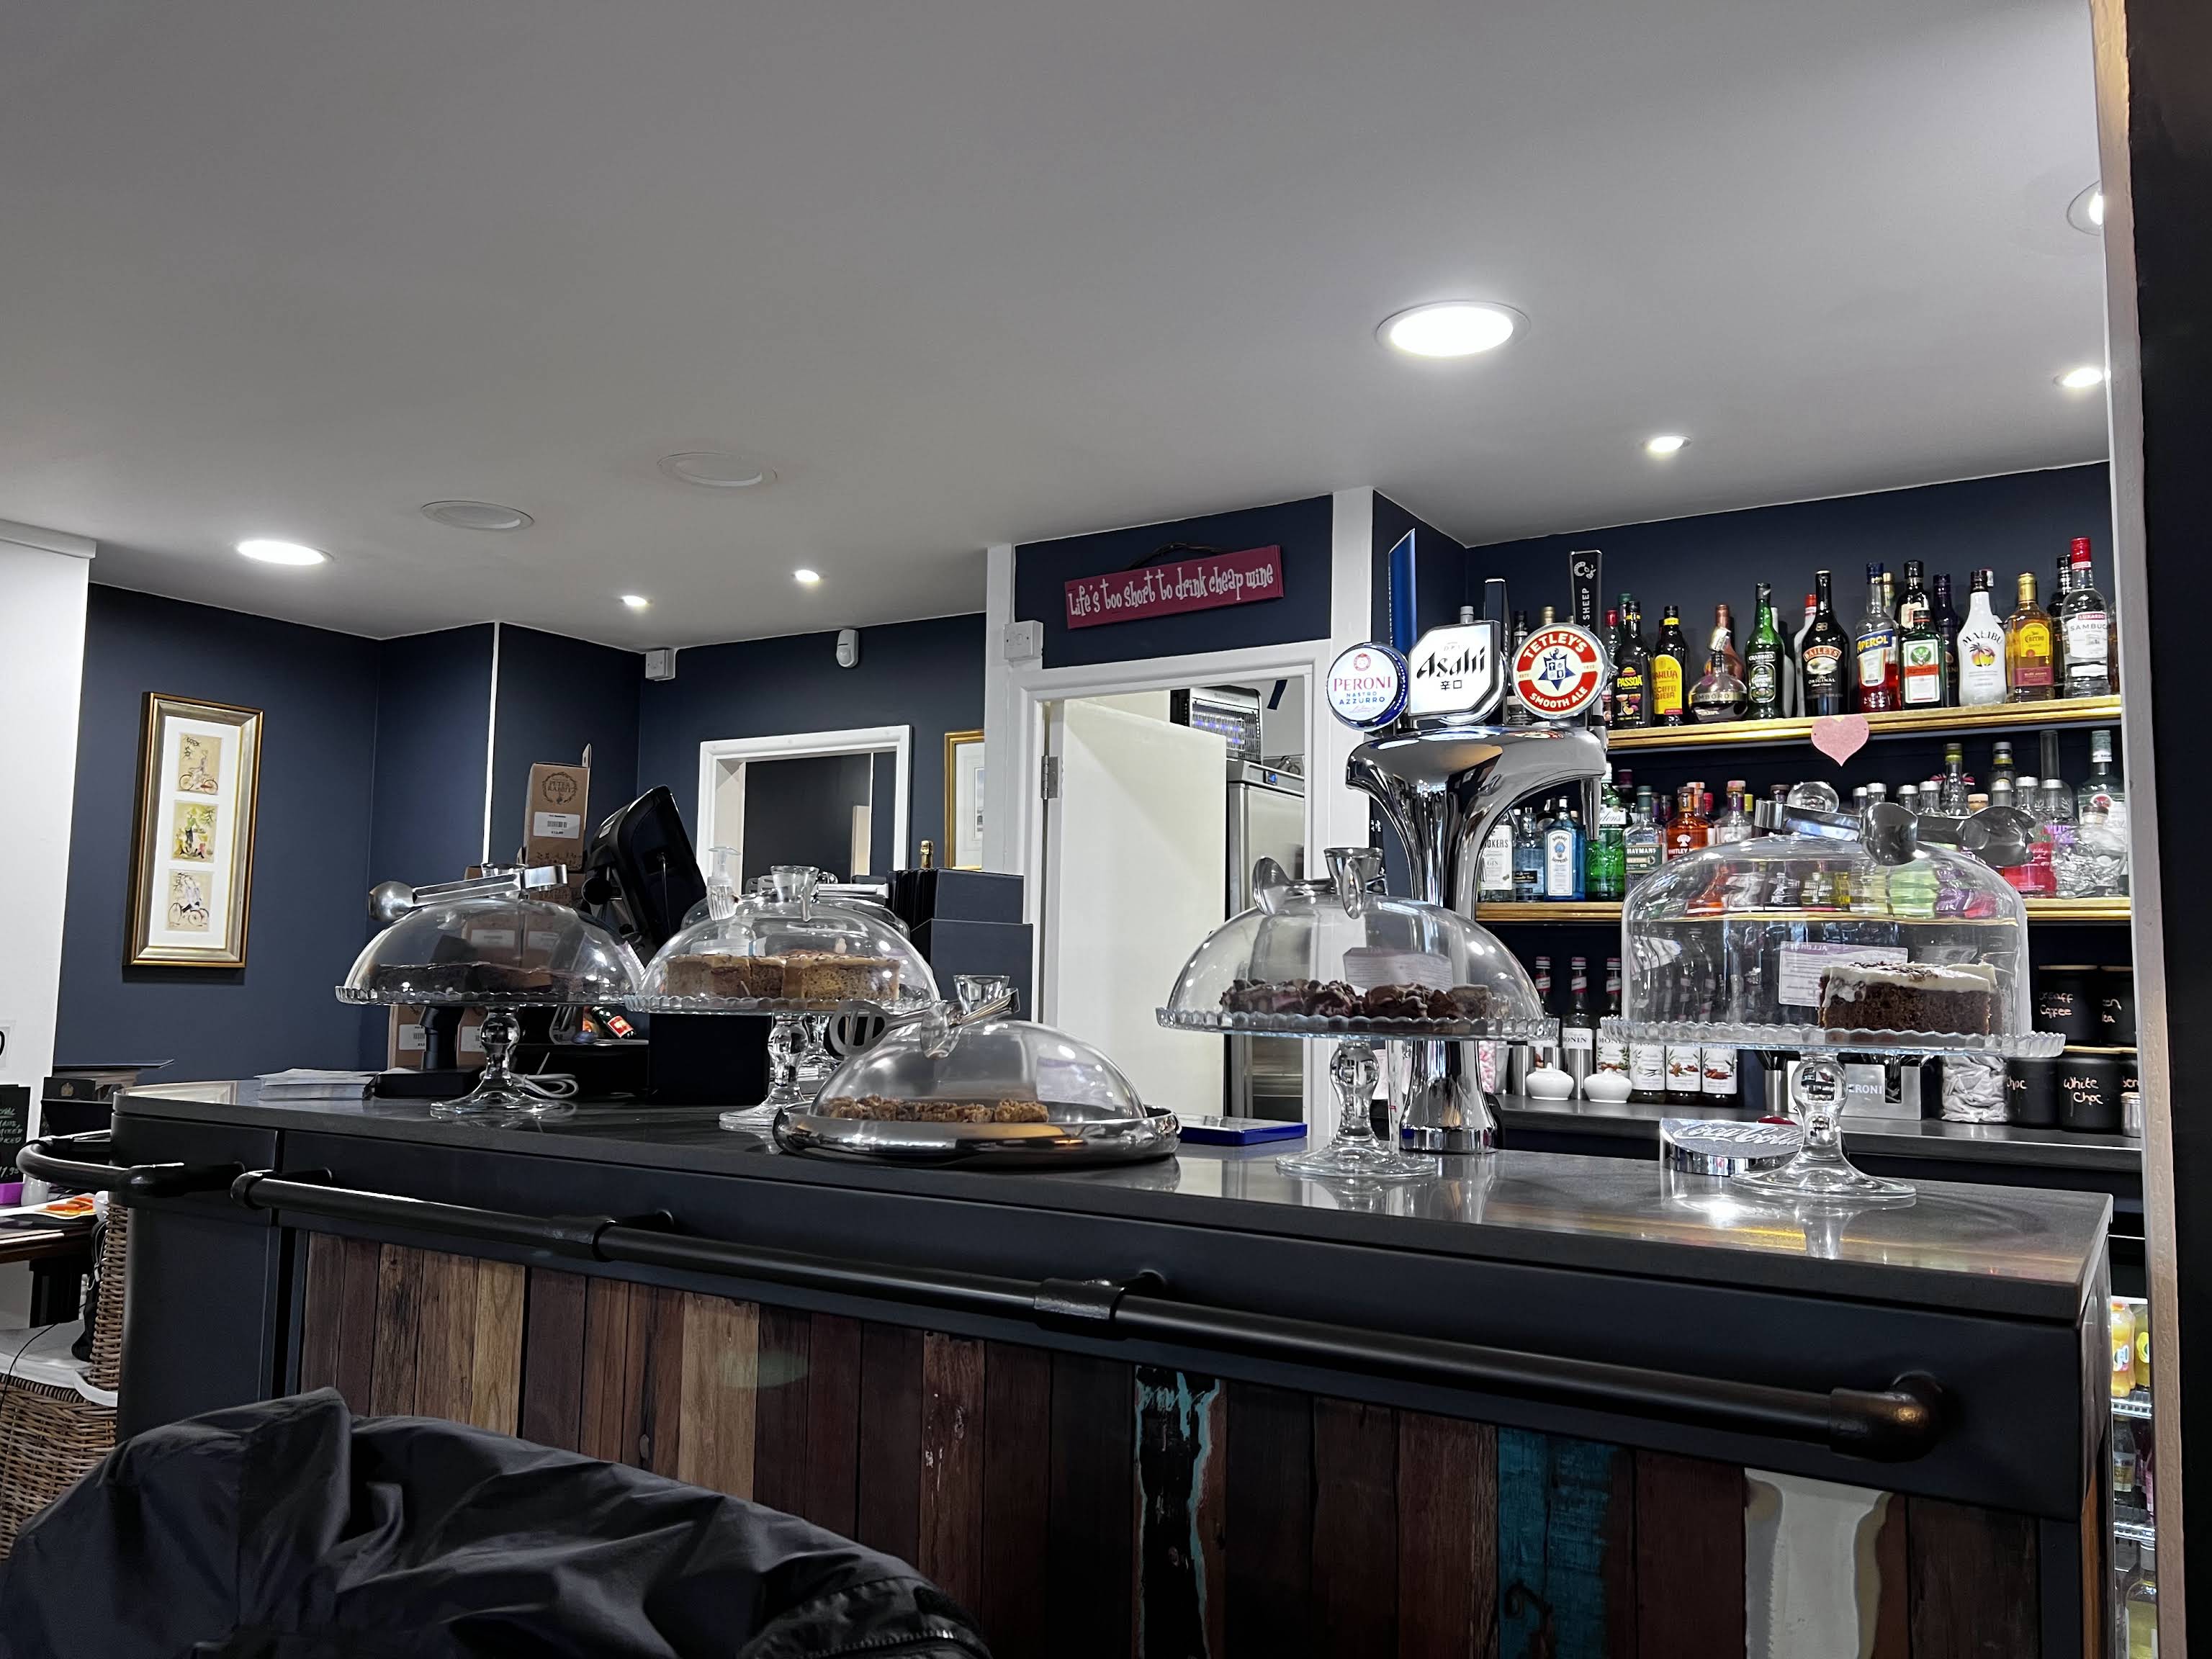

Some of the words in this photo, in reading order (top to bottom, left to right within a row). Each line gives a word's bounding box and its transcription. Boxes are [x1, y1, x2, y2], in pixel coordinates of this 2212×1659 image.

[1069, 585, 1100, 617] Life's
[1100, 578, 1123, 611] too
[1156, 569, 1174, 601] to
[1175, 567, 1209, 601] drink
[1209, 567, 1244, 601] cheap
[1245, 563, 1274, 590] wine
[1581, 588, 1591, 620] SHEEP
[1524, 633, 1588, 658] TETLEY'S
[1858, 635, 1888, 652] APEROL
[1963, 630, 2003, 647] MALIBU
[1804, 647, 1839, 660] BAILEYS
[1416, 646, 1485, 679] Asahi
[1334, 676, 1391, 692] PERONI
[1440, 680, 1462, 691] 辛口
[1339, 696, 1385, 705] AZZURRO
[1529, 692, 1570, 709] SMOOTH
[1571, 686, 1588, 703] ALE
[1485, 839, 1509, 848] OKERS
[1848, 1084, 1882, 1094] ERONI
